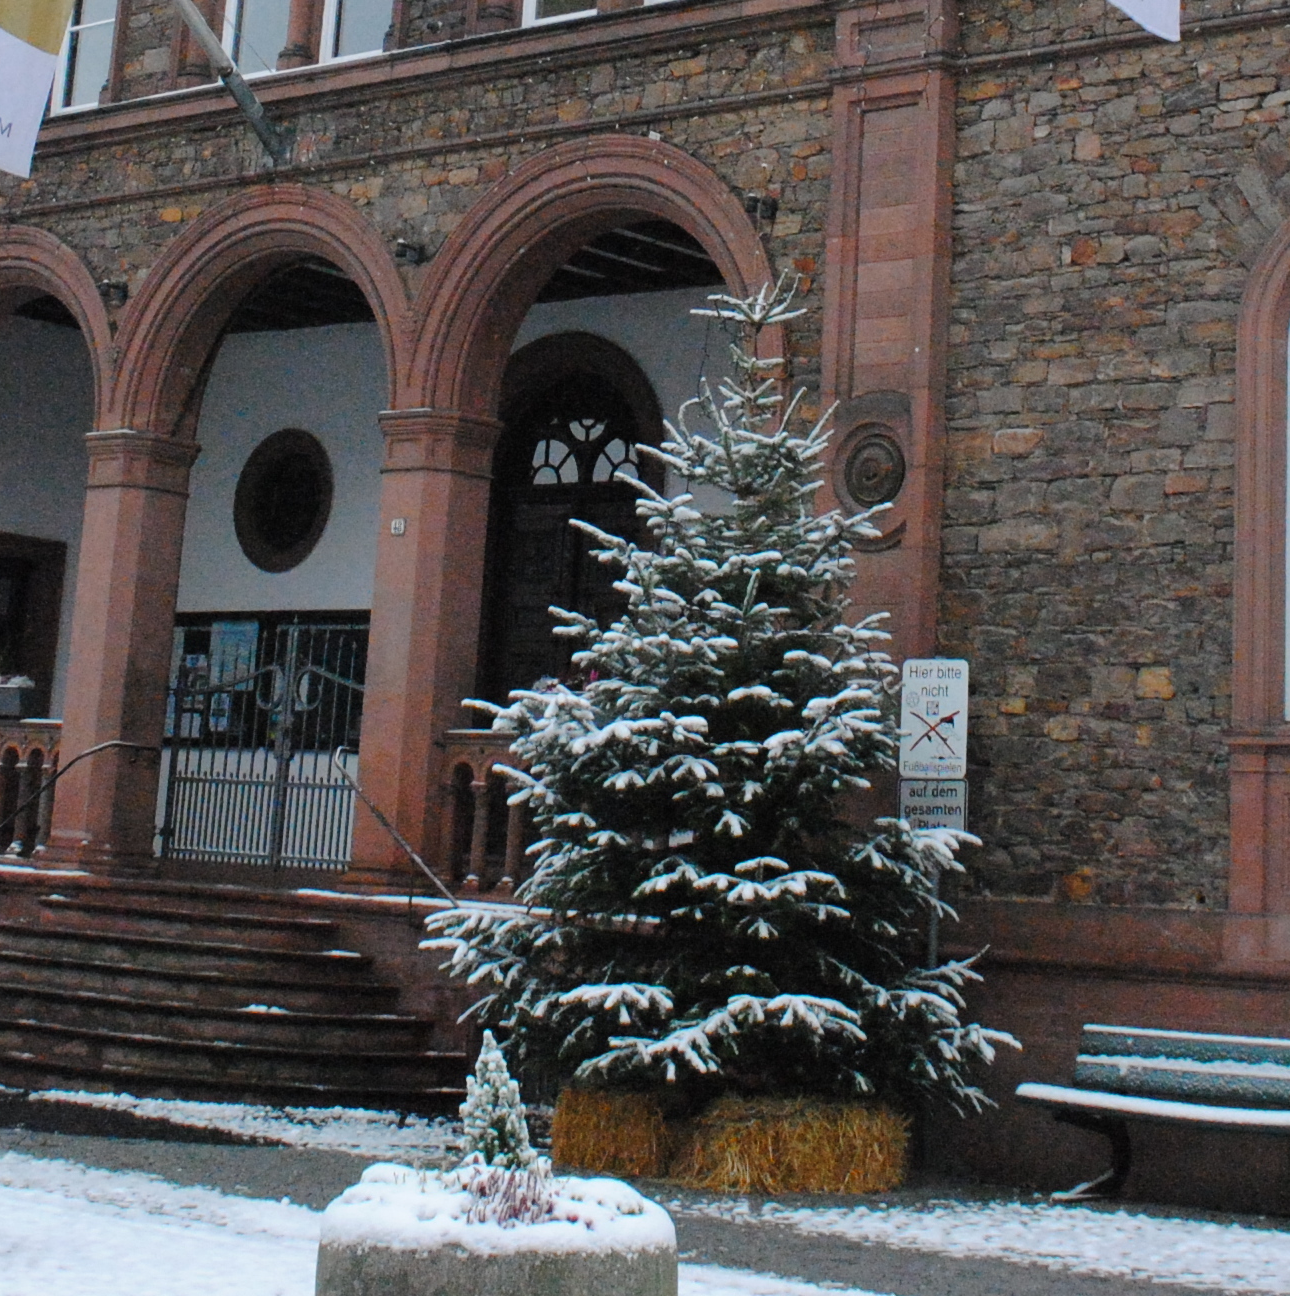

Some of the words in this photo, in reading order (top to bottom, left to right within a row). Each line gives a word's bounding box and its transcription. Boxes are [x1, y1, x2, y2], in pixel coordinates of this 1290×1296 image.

[908, 665, 933, 679] Hier
[937, 665, 962, 679] bitte
[921, 684, 949, 697] nicht
[909, 784, 928, 797] auf
[932, 784, 958, 797] dem
[904, 803, 962, 818] gesamten
